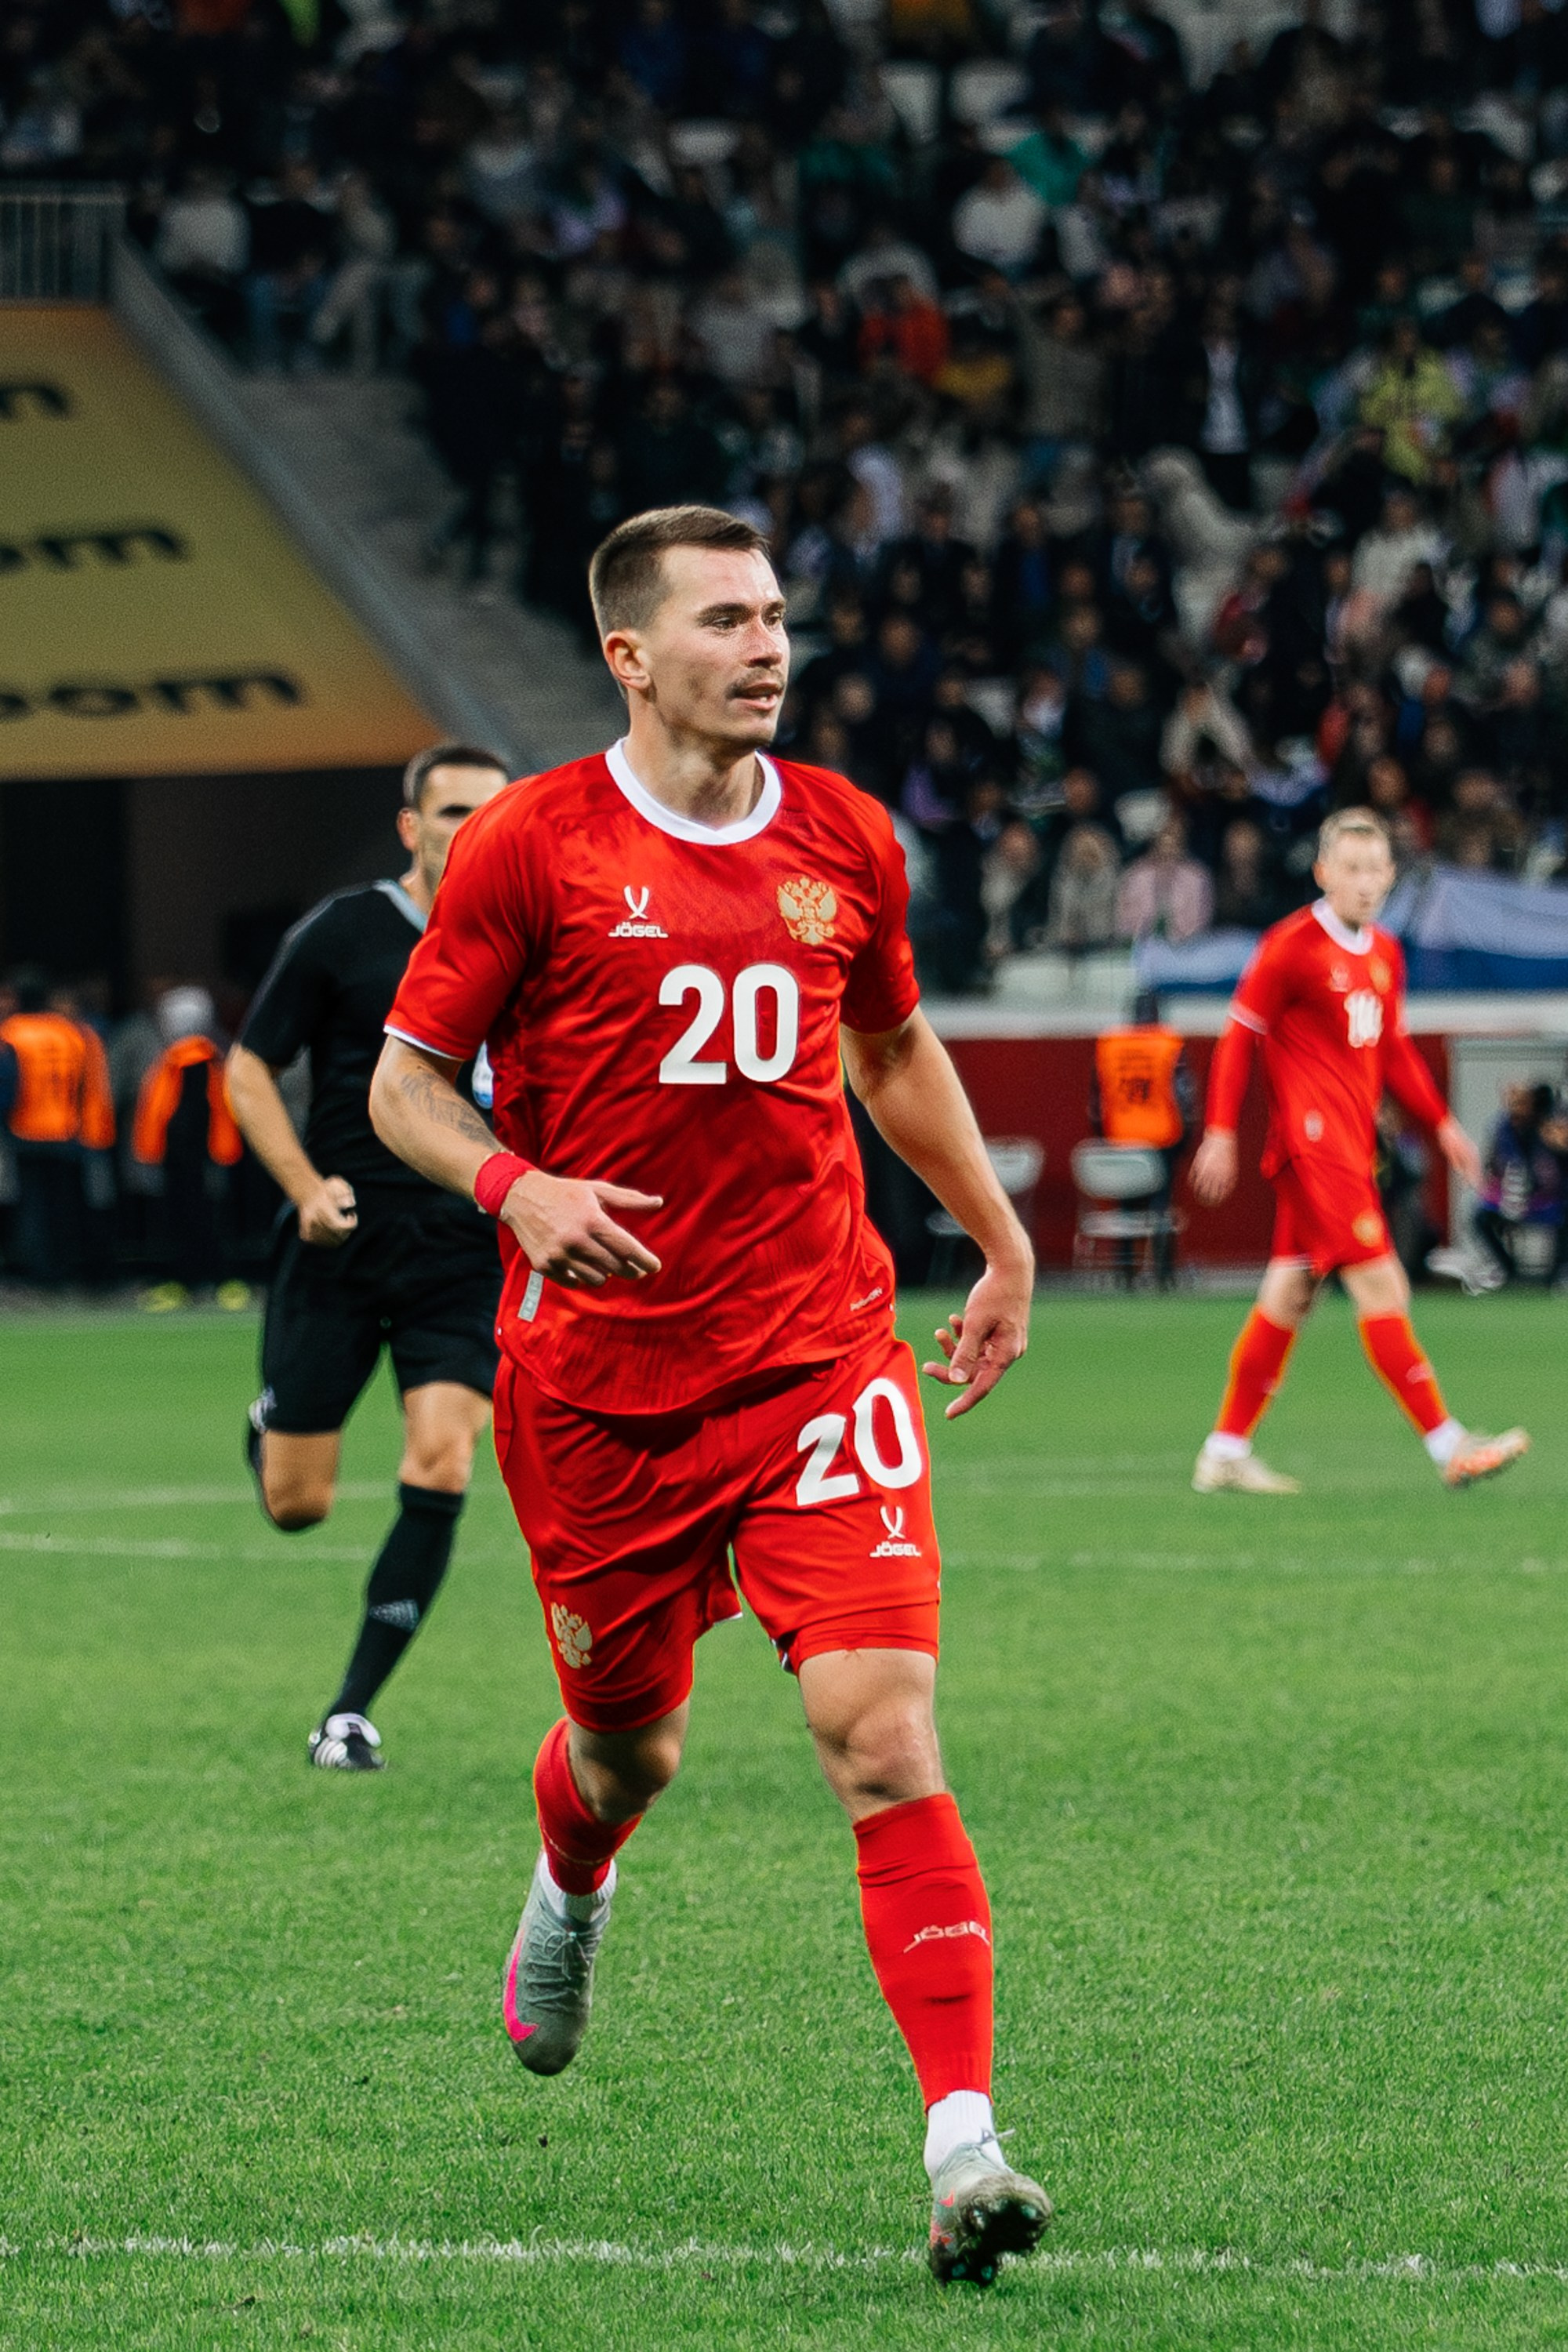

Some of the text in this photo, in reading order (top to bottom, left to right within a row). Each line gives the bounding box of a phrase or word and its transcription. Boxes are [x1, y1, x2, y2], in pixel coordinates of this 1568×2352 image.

[608, 921, 669, 938] JÖGEL
[659, 964, 799, 1084] 20
[796, 1377, 921, 1506] 20
[869, 1541, 921, 1558] JÖGEL
